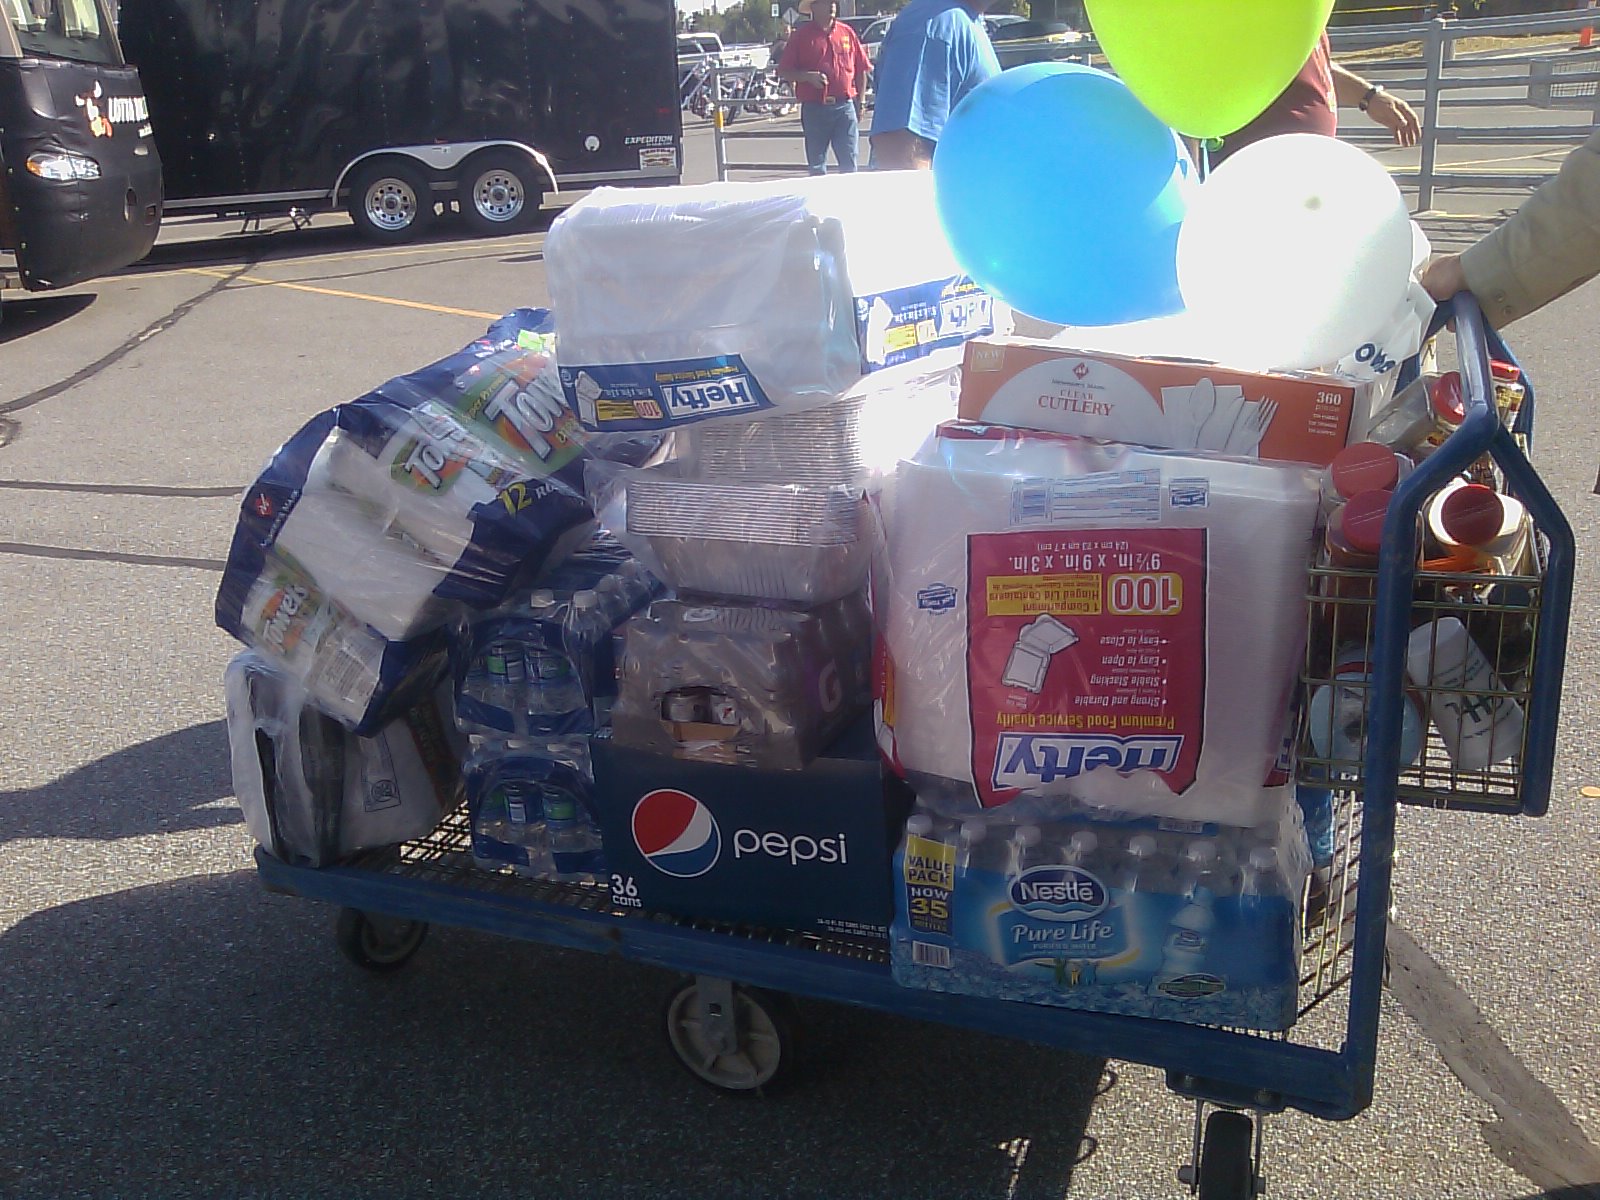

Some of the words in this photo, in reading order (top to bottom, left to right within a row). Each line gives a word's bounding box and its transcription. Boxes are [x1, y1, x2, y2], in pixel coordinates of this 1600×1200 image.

[624, 135, 673, 145] EXPEDITION
[671, 380, 750, 410] Hefty
[1316, 391, 1342, 406] 360
[1038, 395, 1116, 416] CUTLERY
[500, 482, 532, 517] 12
[1045, 555, 1053, 568] x
[1098, 554, 1106, 567] x
[1044, 590, 1060, 600] Lid
[1063, 589, 1099, 600] Hinged
[1114, 577, 1178, 611] 100
[1100, 636, 1125, 647] Close
[1139, 634, 1159, 647] Easy
[1102, 654, 1125, 667] Open
[1139, 655, 1159, 667] Easy
[1090, 674, 1129, 687] Stacking
[1131, 676, 1160, 687] Stable
[1075, 695, 1109, 707] Durable
[1112, 696, 1129, 707] and
[1131, 694, 1160, 707] Strong
[996, 712, 1036, 728] Quality
[1039, 713, 1083, 729] Service
[1088, 714, 1117, 729] Food
[1121, 714, 1175, 730] Premium
[733, 829, 848, 865] pepsi
[908, 855, 953, 873] VALUE
[908, 868, 951, 884] PACK
[611, 874, 638, 897] 36
[911, 886, 949, 900] NOW
[612, 895, 643, 908] cans
[911, 898, 949, 919] 35
[1010, 924, 1066, 943] Pure
[1070, 920, 1115, 942] Life
